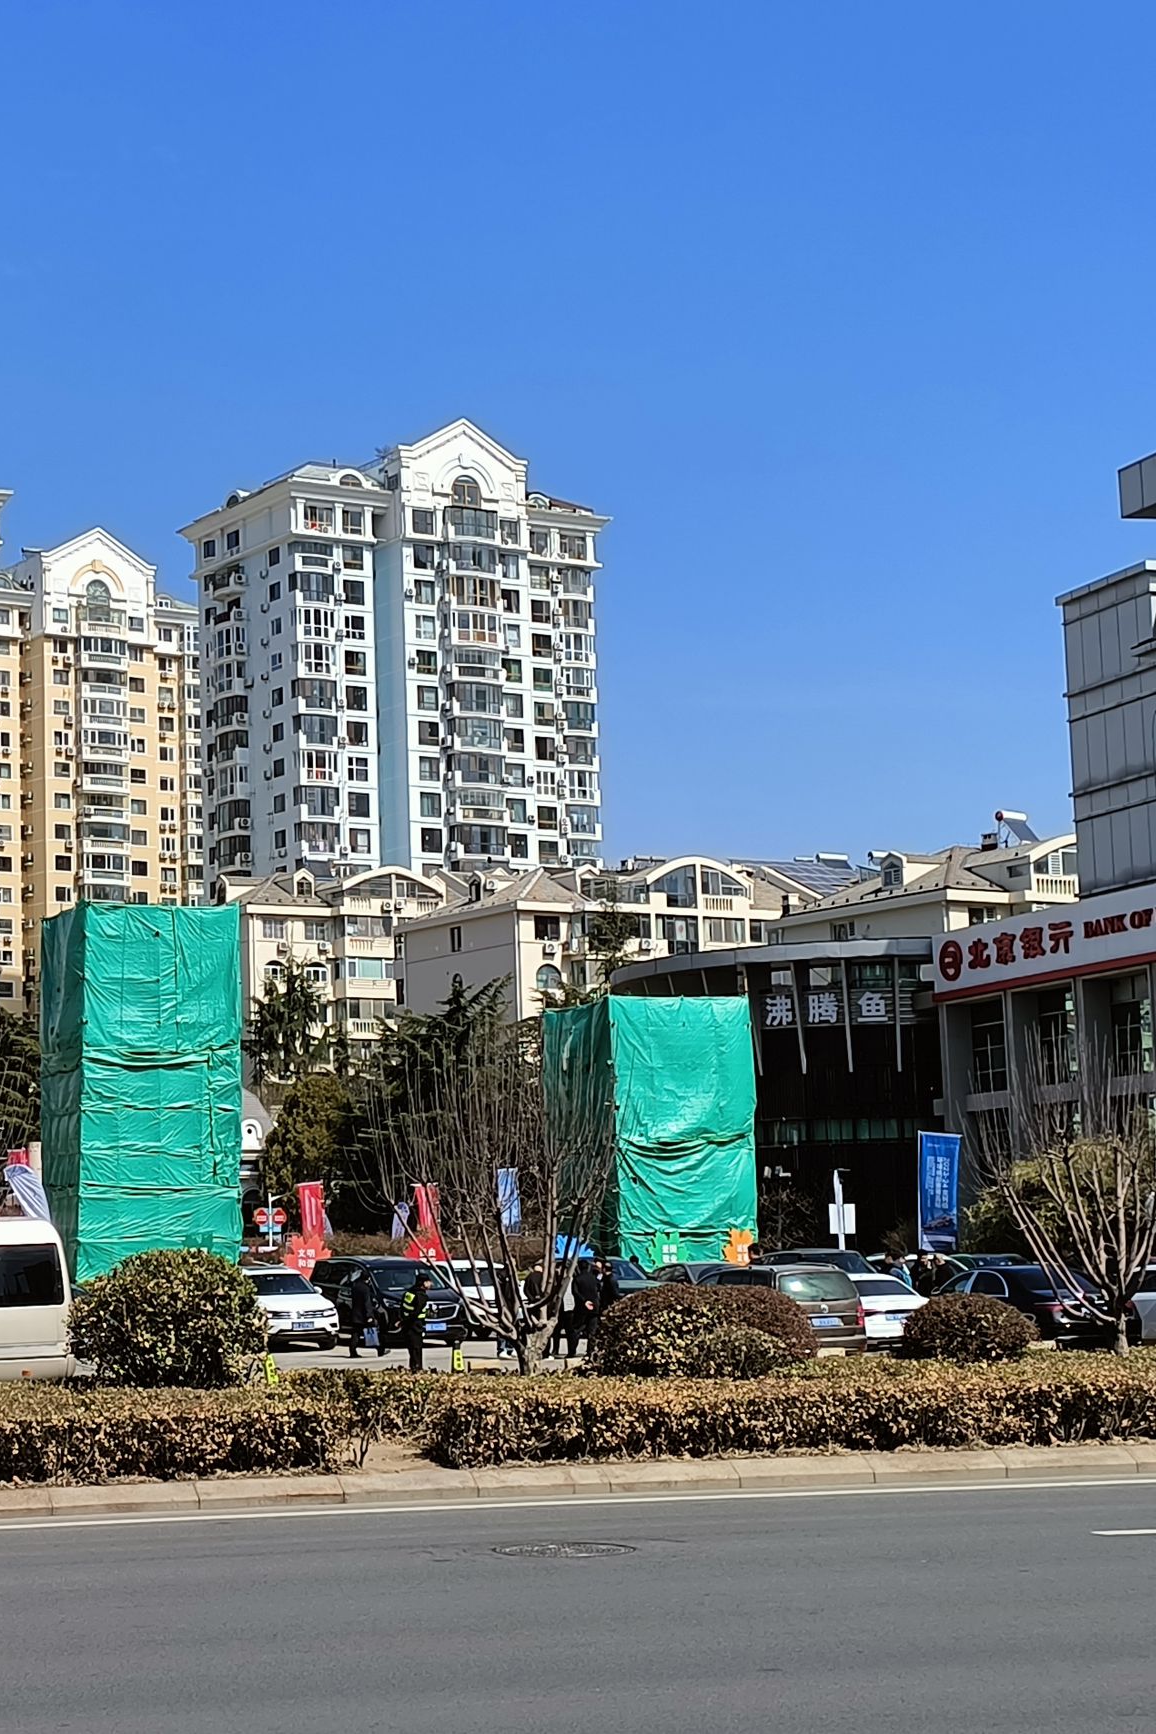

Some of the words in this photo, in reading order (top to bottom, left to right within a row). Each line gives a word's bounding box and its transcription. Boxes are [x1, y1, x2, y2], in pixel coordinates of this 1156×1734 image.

[1083, 914, 1128, 939] BANK
[1130, 908, 1153, 929] OF
[968, 921, 1074, 969] 北京银行
[765, 991, 889, 1026] 沸腾鱼
[298, 1248, 315, 1258] 文明
